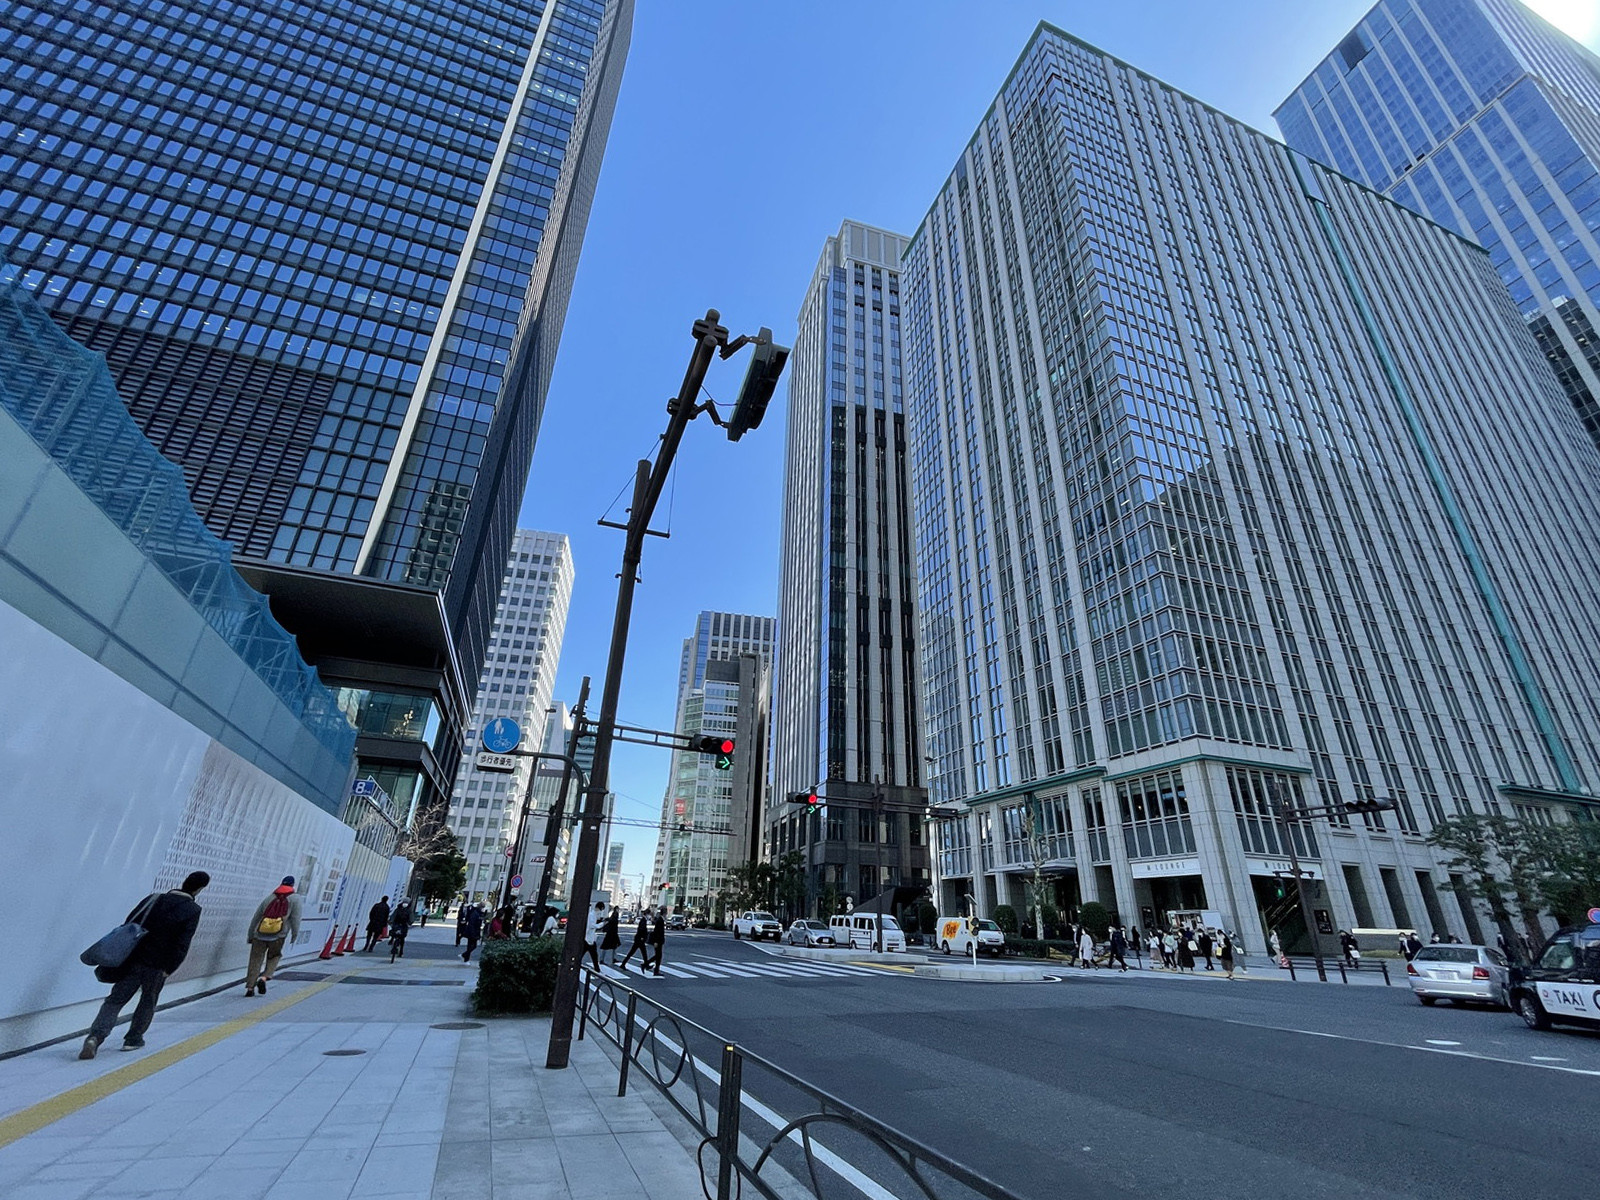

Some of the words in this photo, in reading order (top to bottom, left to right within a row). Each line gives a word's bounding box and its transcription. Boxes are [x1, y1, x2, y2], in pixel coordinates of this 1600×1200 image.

[480, 755, 512, 766] 歩行者優先
[355, 781, 366, 794] 8
[1155, 861, 1185, 871] LOUNGE
[1552, 989, 1585, 1007] TAXI
